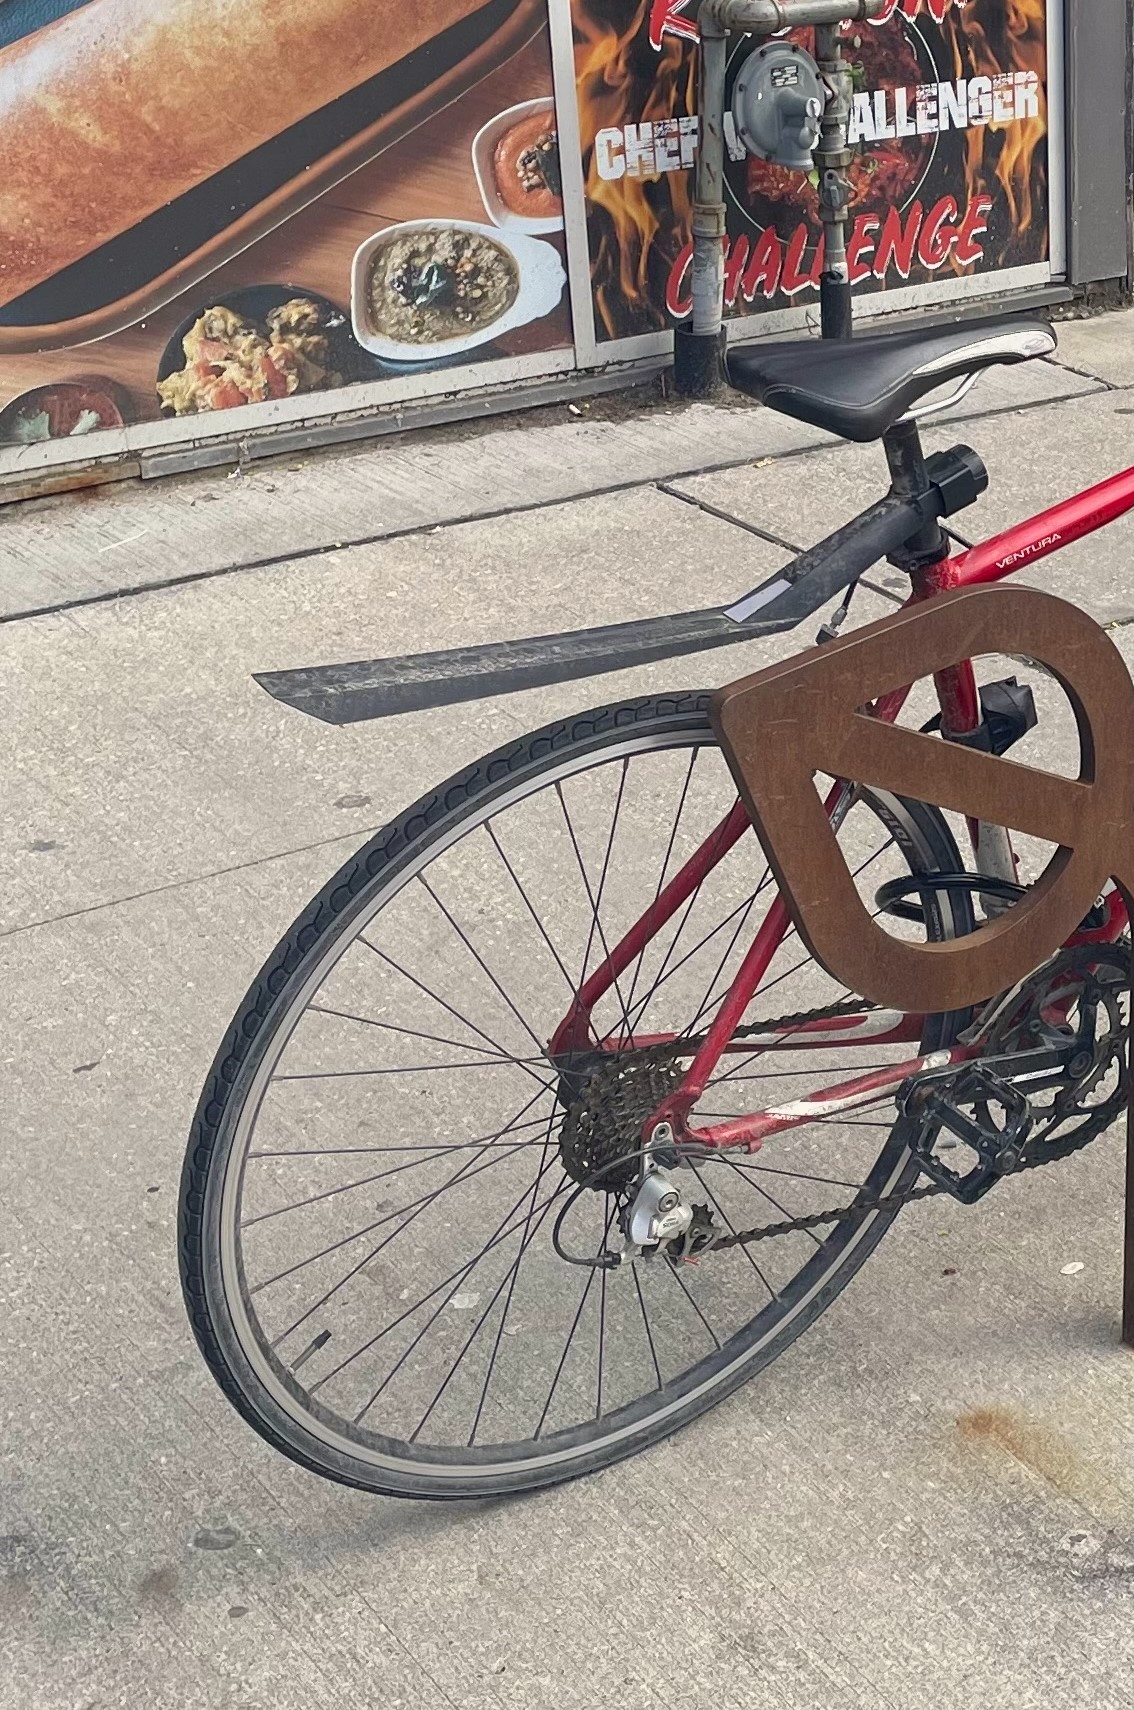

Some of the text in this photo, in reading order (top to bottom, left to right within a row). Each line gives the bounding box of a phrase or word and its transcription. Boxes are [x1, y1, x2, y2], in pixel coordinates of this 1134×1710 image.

[594, 115, 699, 181] CHEF
[810, 70, 1039, 149] ALLENGER
[995, 532, 1062, 569] VENTURA
